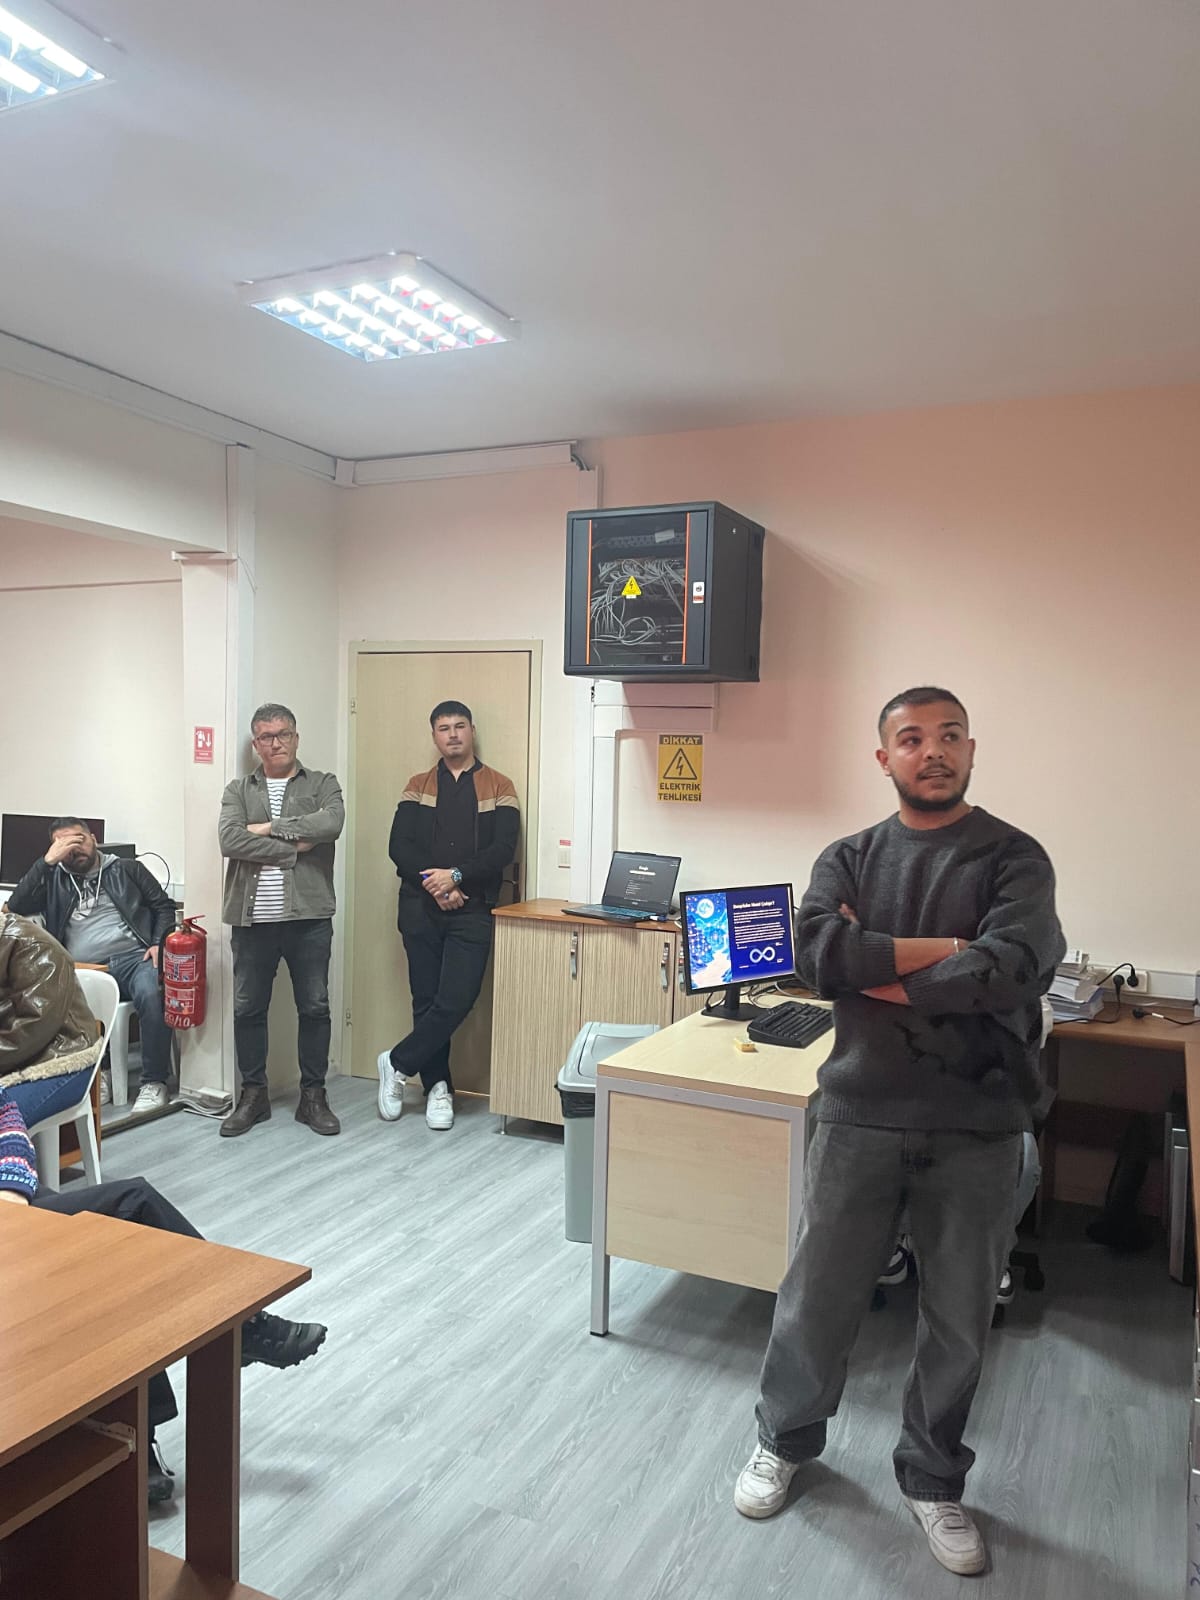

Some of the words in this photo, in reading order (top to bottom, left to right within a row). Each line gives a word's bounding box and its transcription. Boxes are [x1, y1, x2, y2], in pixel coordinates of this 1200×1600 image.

[663, 736, 700, 744] DİKKAT
[659, 783, 700, 791] ELEKTRİK
[658, 793, 702, 802] TEHLİKESİ
